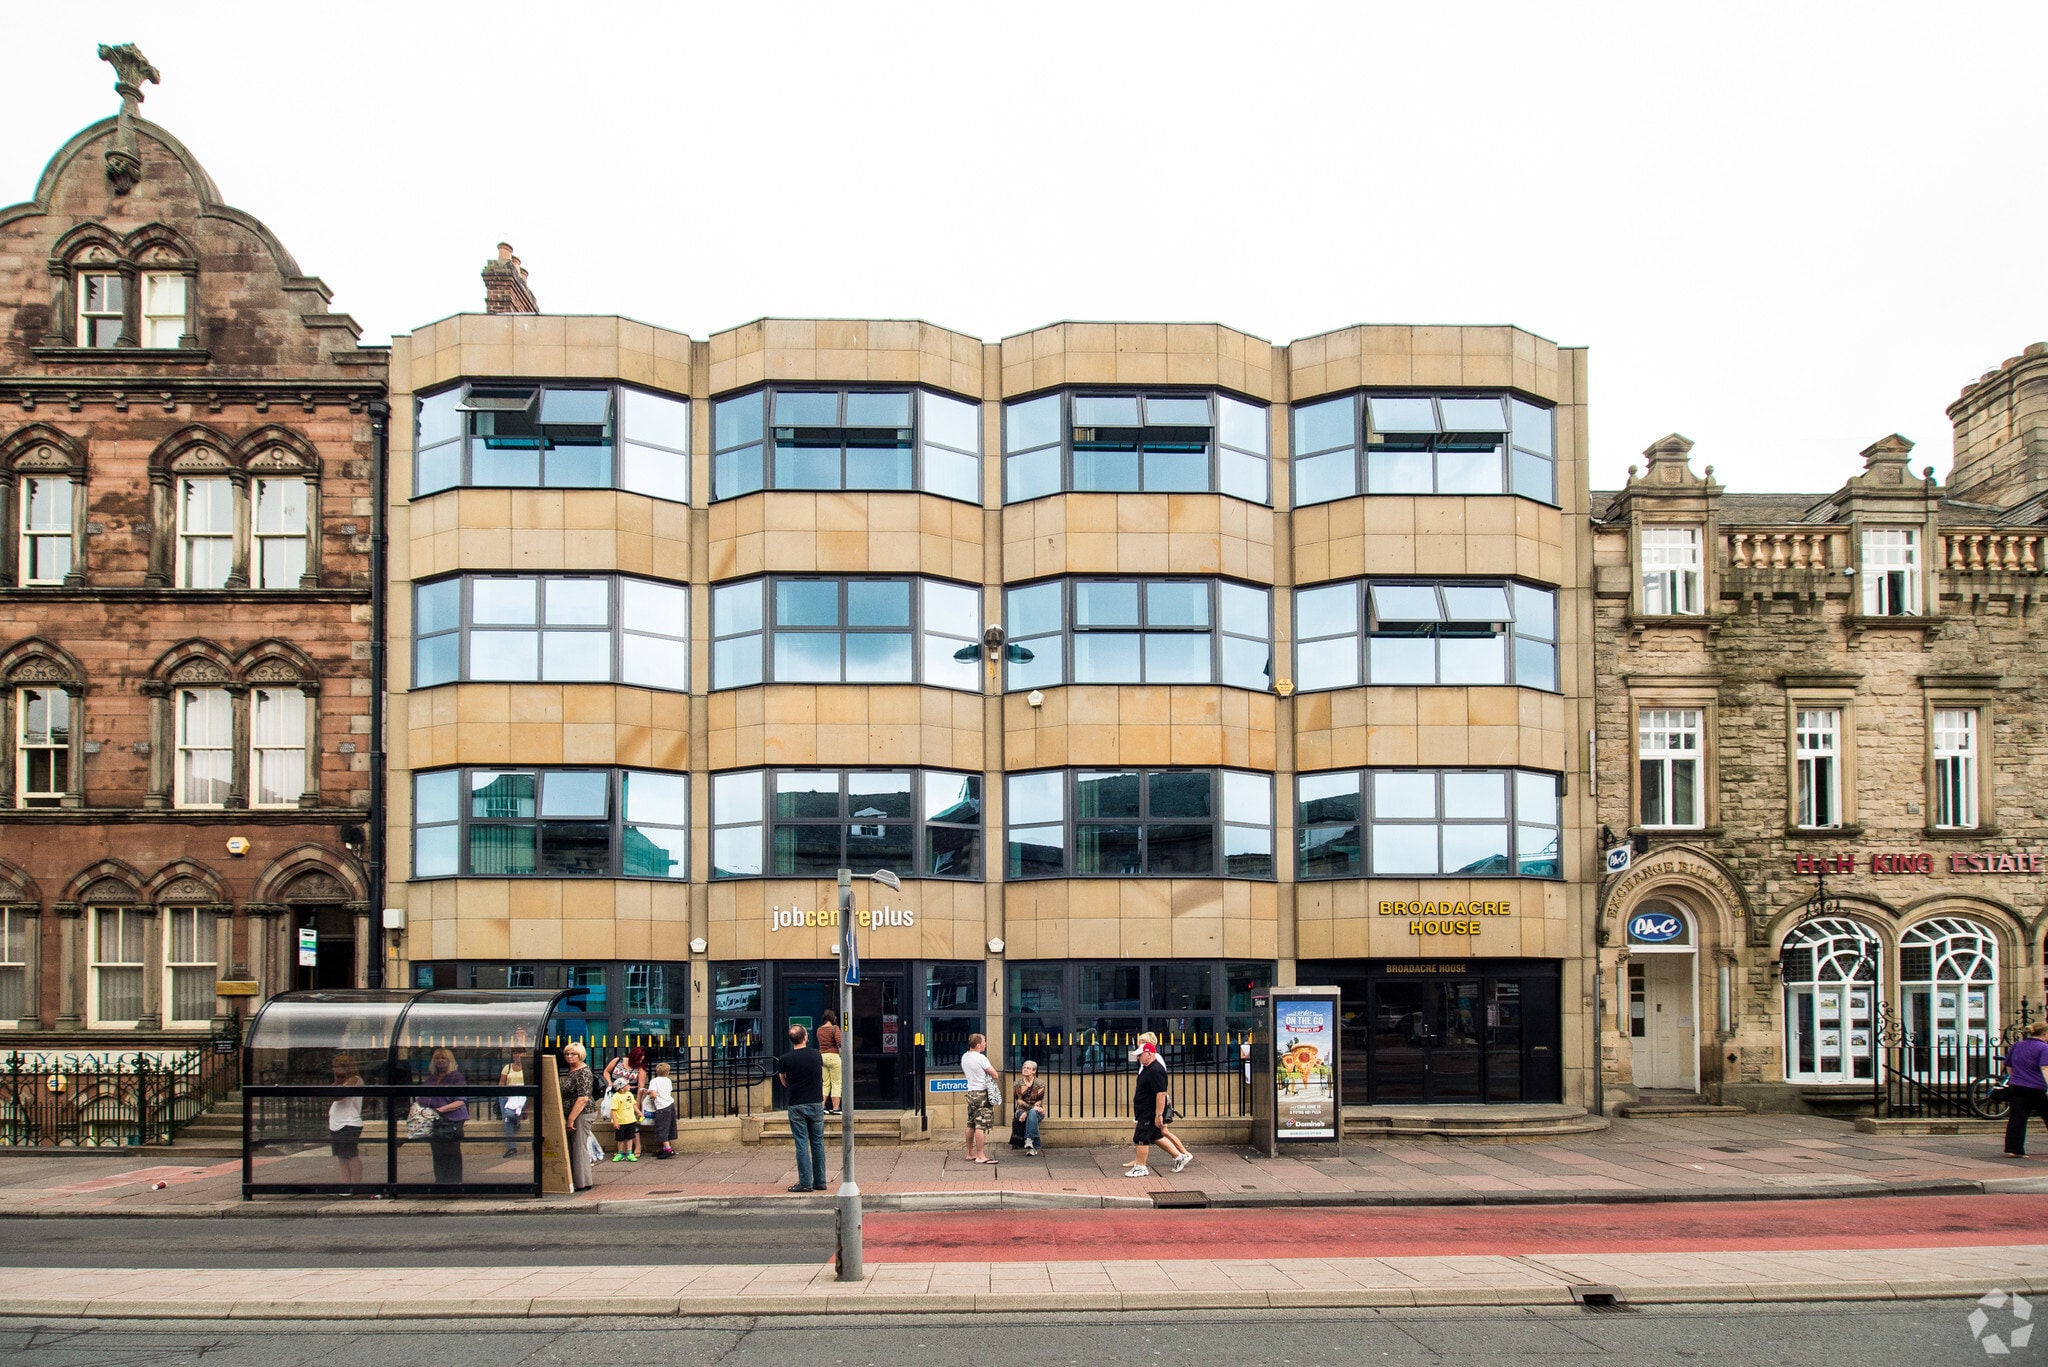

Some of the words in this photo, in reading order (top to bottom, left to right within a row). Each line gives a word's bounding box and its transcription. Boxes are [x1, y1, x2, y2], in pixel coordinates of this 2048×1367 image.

[1872, 853, 1934, 874] KING
[1952, 853, 2044, 873] ESTATE
[1607, 862, 1674, 919] EXCHANGE
[1678, 861, 1746, 918] BUILDINGS
[1379, 901, 1511, 916] BROADACRE
[771, 906, 914, 932] jobceneplus
[1409, 921, 1481, 936] HOUSE
[1386, 964, 1437, 974] BROADACRE
[1439, 964, 1467, 973] HOUSE
[1286, 1017, 1296, 1025] ON
[1297, 1017, 1312, 1025] THE
[1314, 1017, 1324, 1025] GO
[937, 1082, 968, 1090] Entranc
